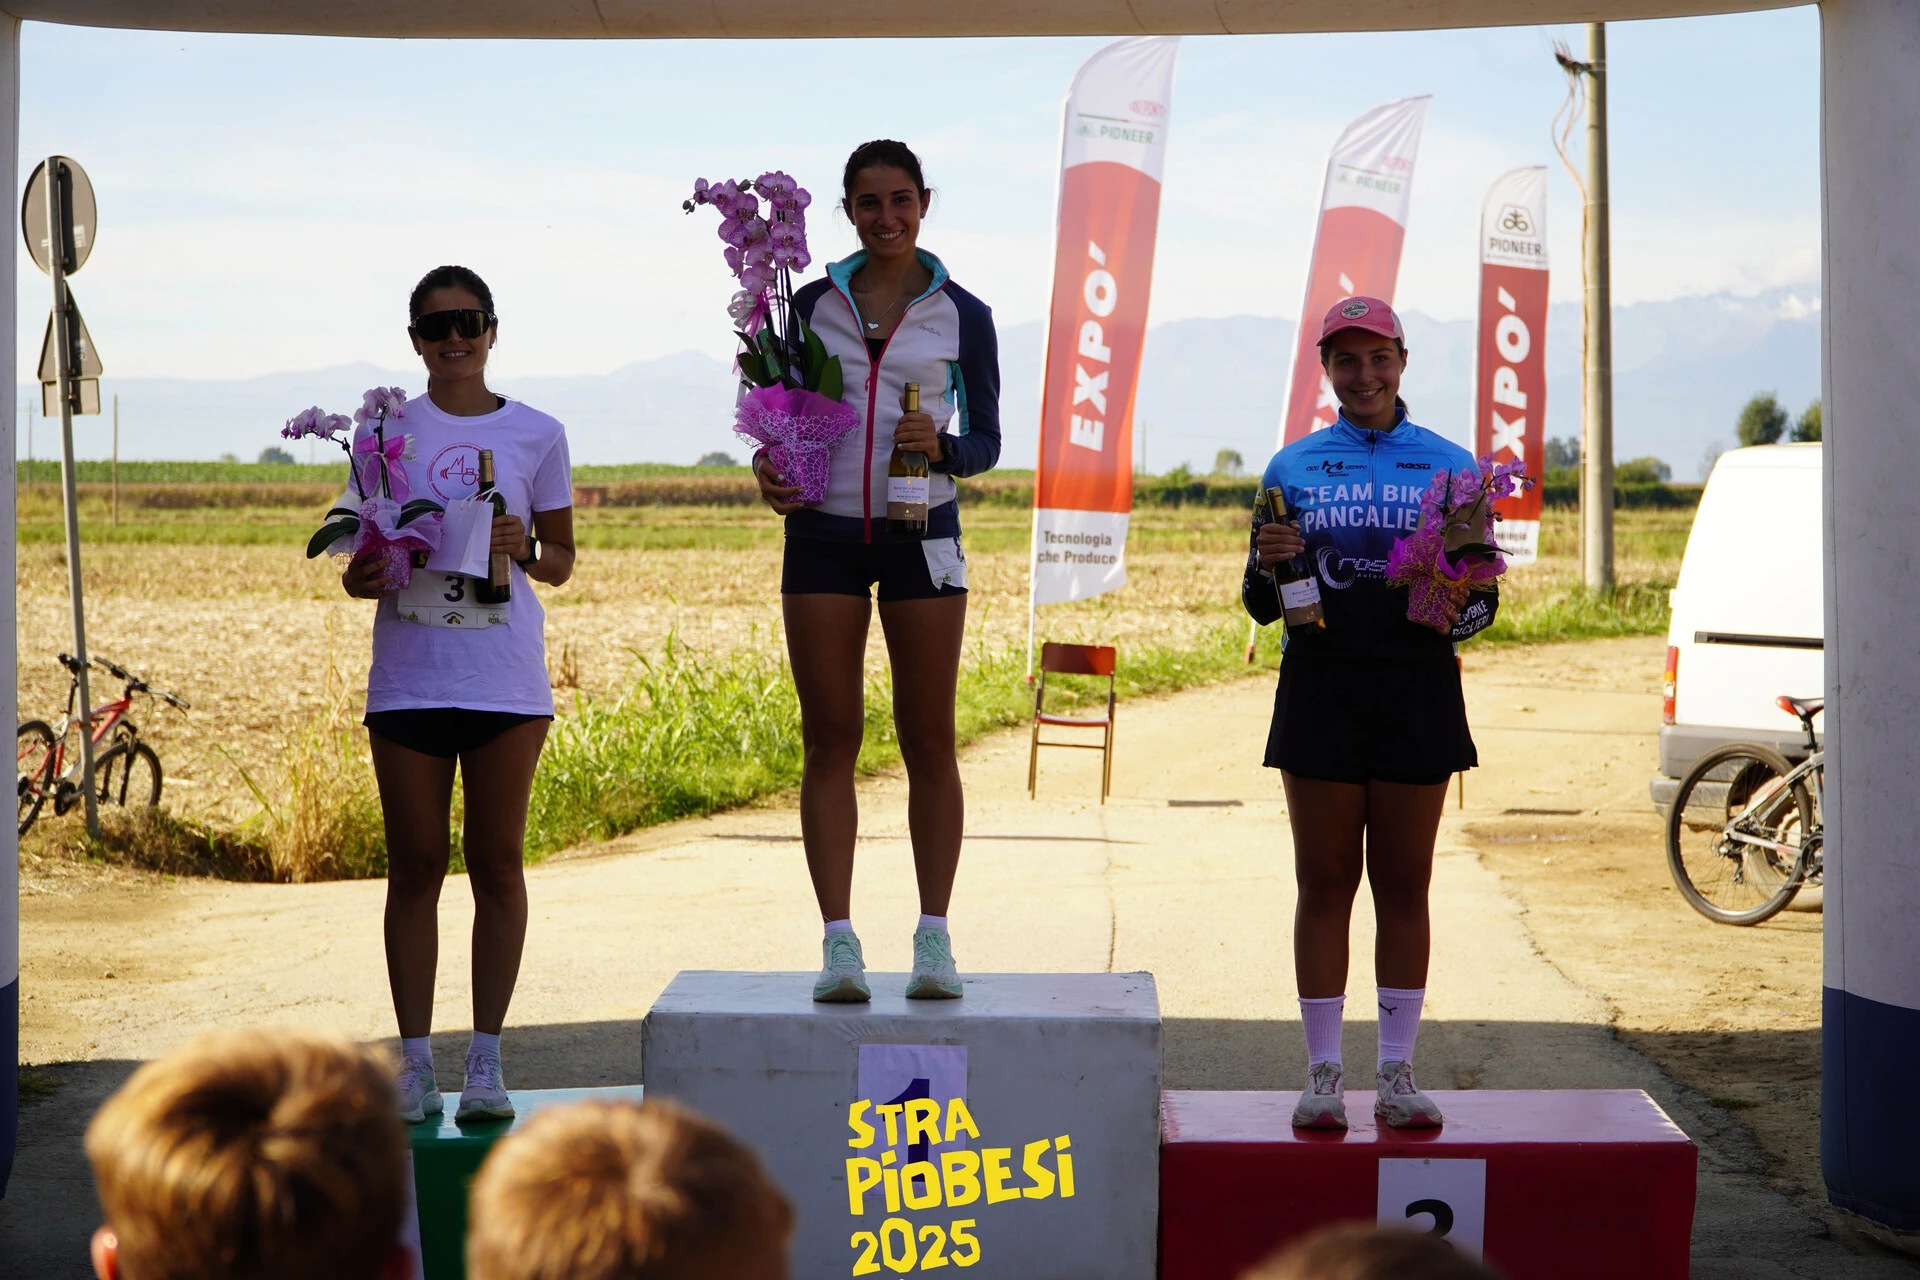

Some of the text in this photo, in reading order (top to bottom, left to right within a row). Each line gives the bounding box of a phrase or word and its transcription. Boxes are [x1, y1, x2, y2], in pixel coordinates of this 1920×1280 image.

[1099, 125, 1154, 145] PIONEER
[1489, 236, 1543, 257] PIONEER
[1303, 482, 1424, 506] TEAM BIK
[1304, 505, 1420, 534] PANCALIE
[1044, 530, 1113, 549] Tecnologia
[1037, 550, 1060, 564] che
[443, 574, 465, 603] 3
